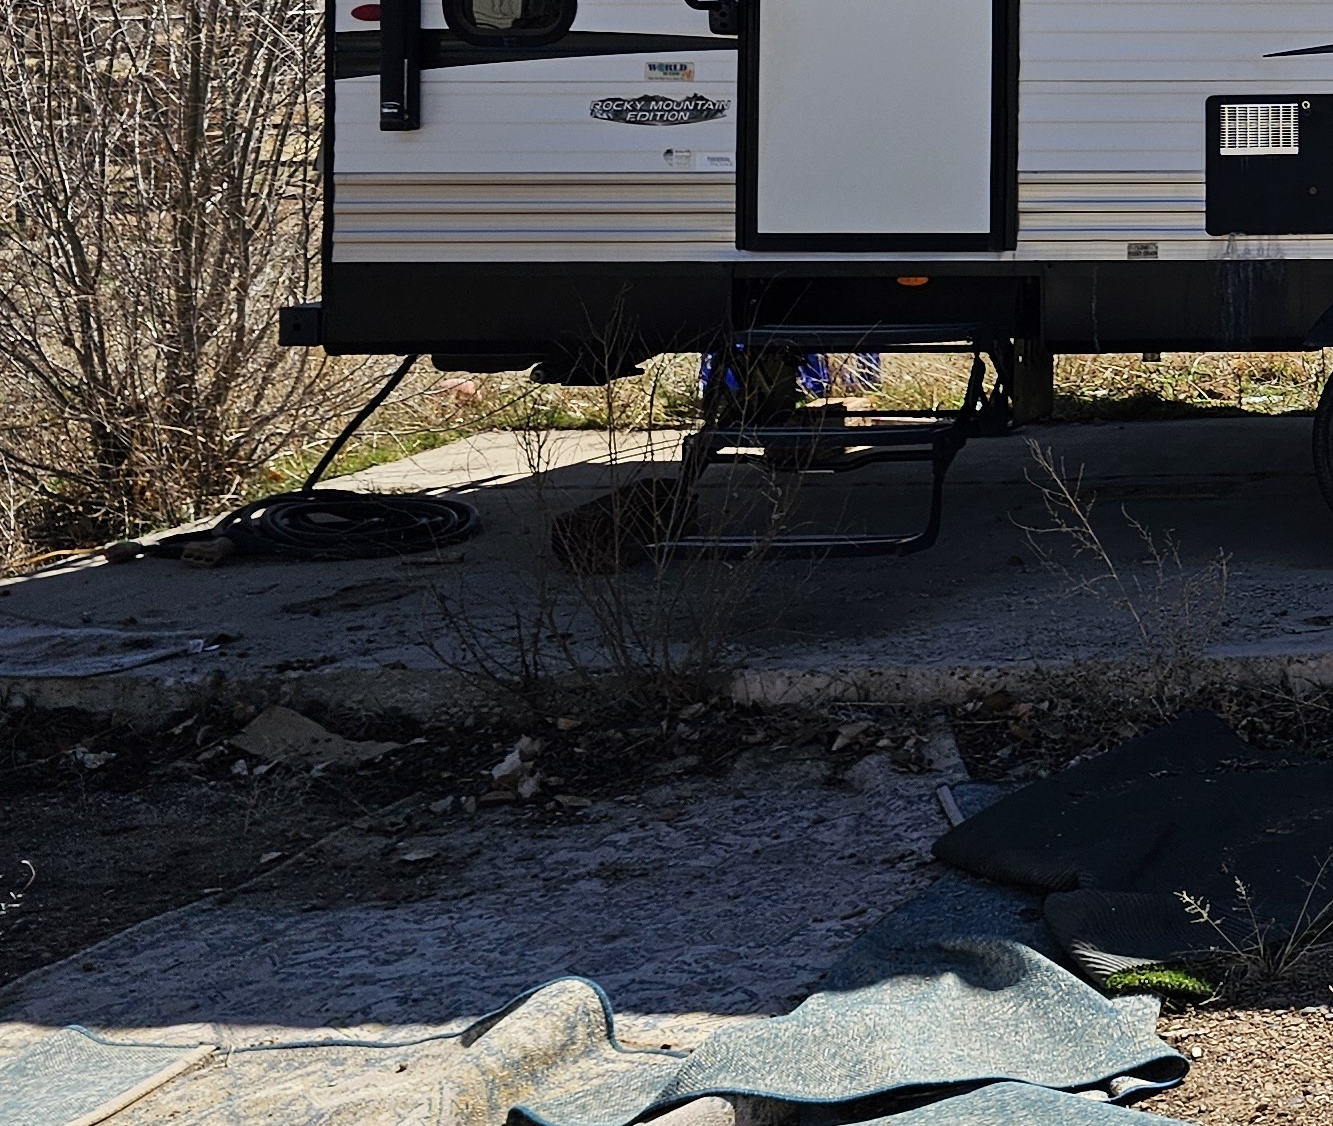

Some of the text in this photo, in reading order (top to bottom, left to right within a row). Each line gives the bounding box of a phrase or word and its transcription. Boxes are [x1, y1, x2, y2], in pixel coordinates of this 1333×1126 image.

[648, 63, 688, 72] WORLD
[590, 100, 731, 111] ROCKY MOUNTAIN
[626, 111, 690, 121] EDITION
